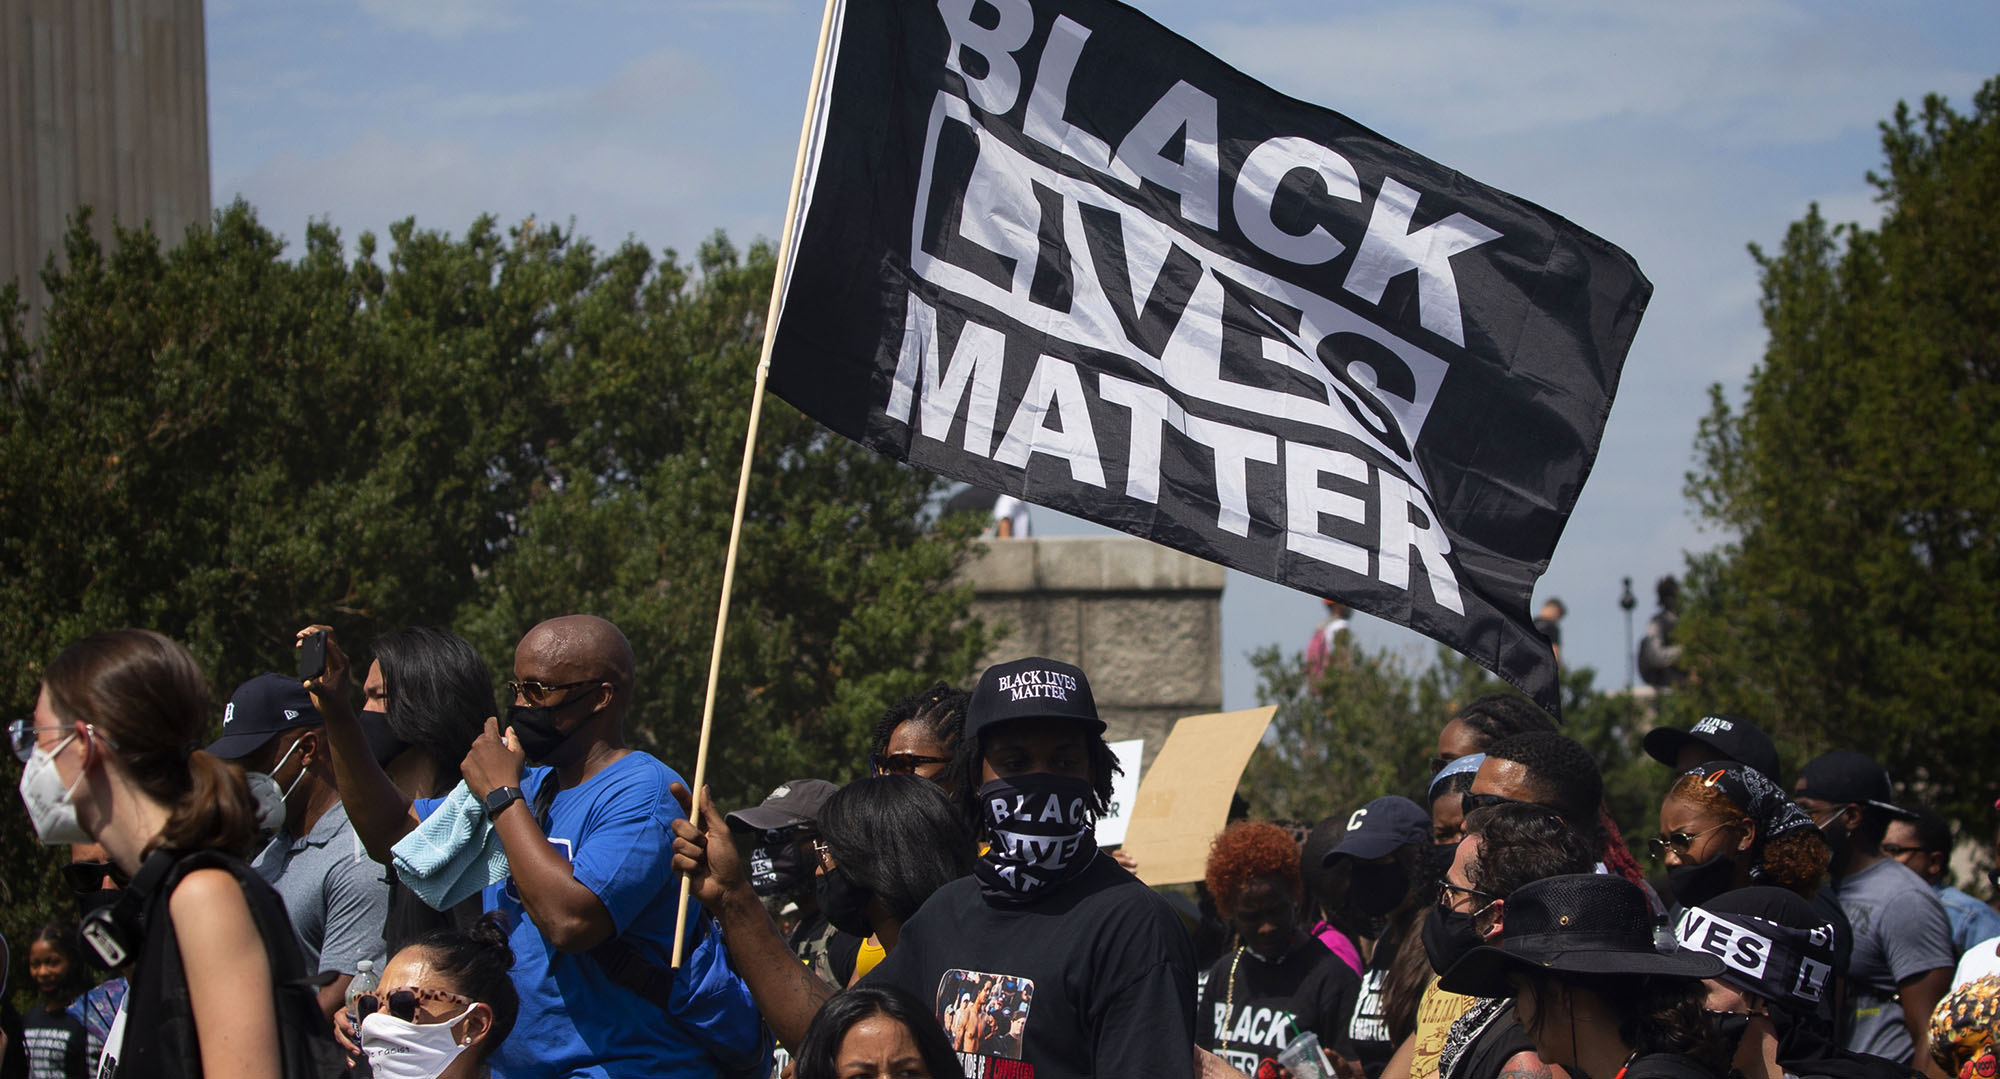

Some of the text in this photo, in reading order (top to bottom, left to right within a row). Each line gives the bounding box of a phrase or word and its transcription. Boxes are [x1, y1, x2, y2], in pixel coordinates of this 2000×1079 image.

[937, 0, 1504, 348] BLACK
[920, 114, 1417, 463] LIVES
[885, 290, 1465, 616] MATTER
[999, 670, 1076, 691] BLACK LIVES
[1011, 684, 1067, 701] MATTER
[991, 793, 1086, 824] BLAC
[1346, 809, 1367, 831] C
[1683, 911, 1764, 969] VES
[1214, 1002, 1297, 1050] BLACK
